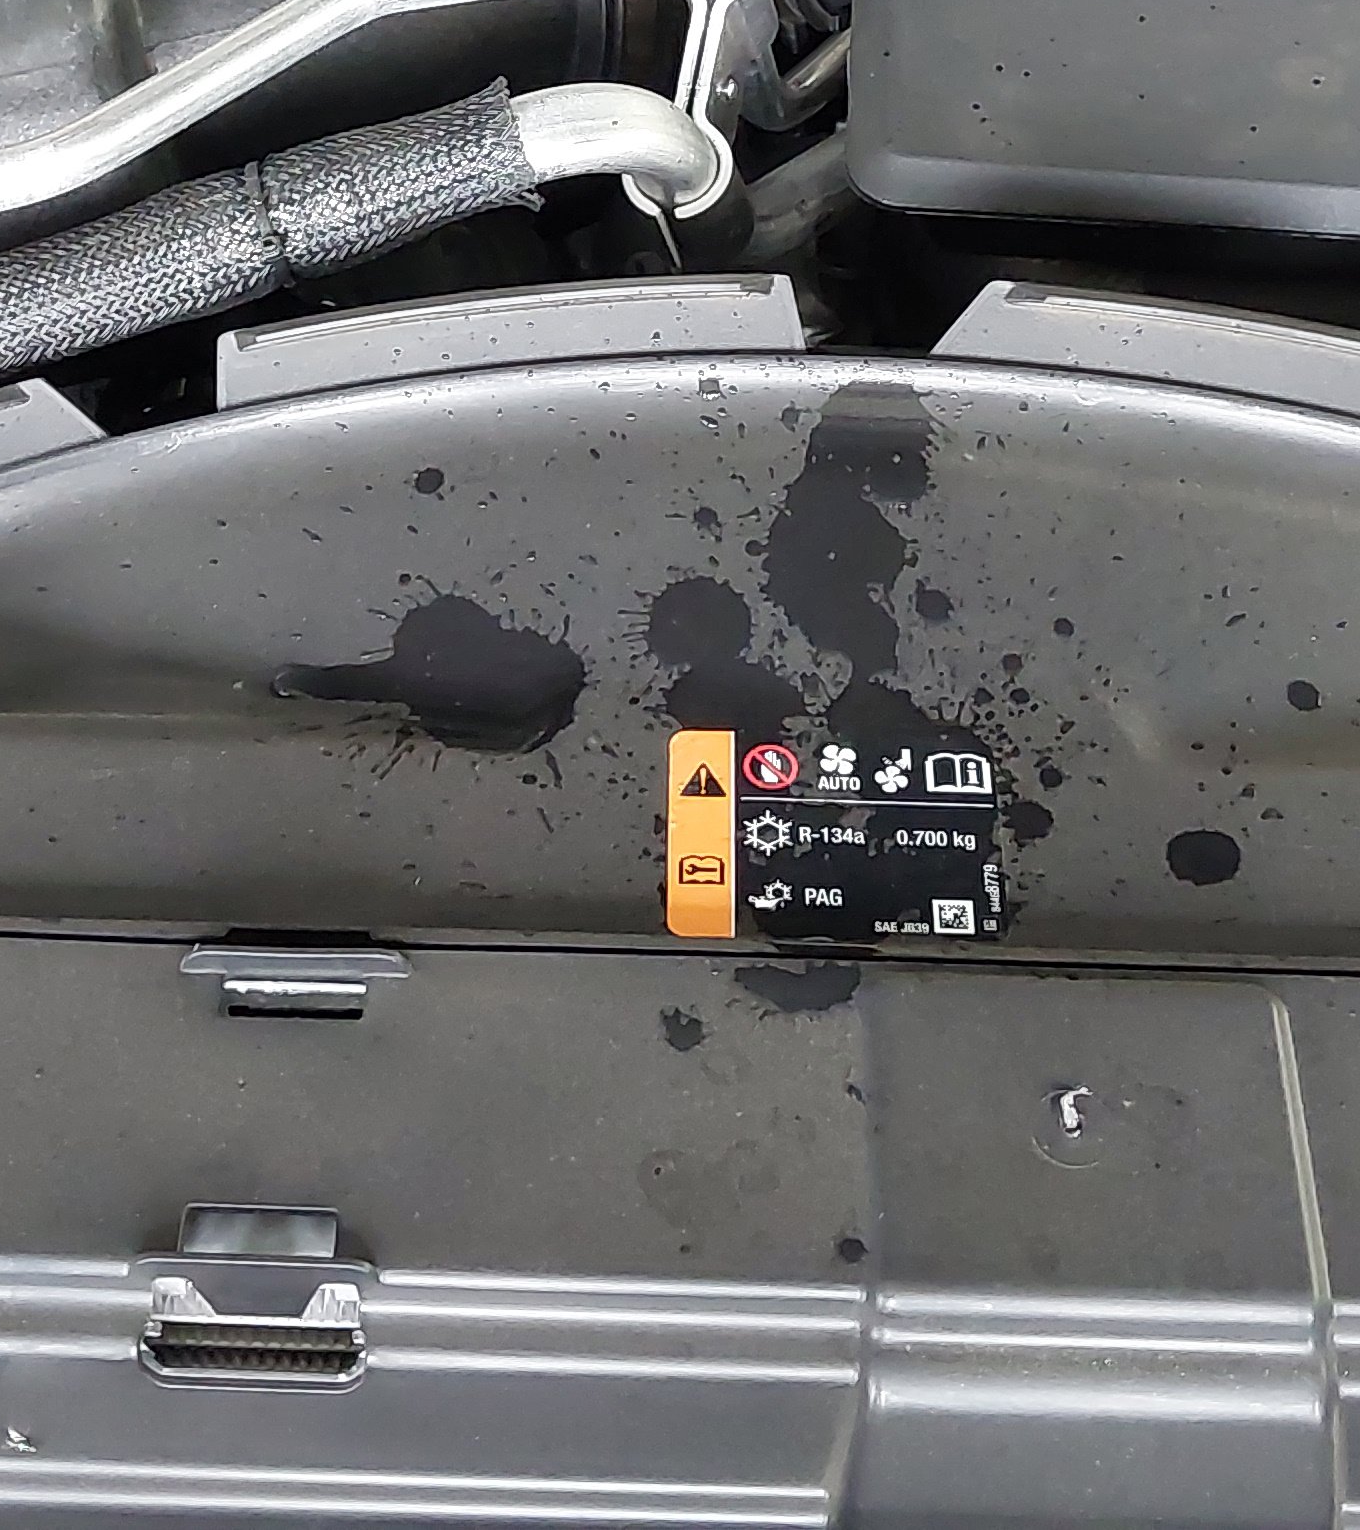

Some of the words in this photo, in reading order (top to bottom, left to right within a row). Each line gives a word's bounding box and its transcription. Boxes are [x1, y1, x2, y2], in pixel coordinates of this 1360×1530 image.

[817, 776, 861, 791] AUTO
[799, 826, 865, 845] R-134a
[896, 829, 948, 846] 0.700
[953, 830, 976, 850] kg
[804, 888, 843, 906] PAG
[874, 921, 898, 933] SAE
